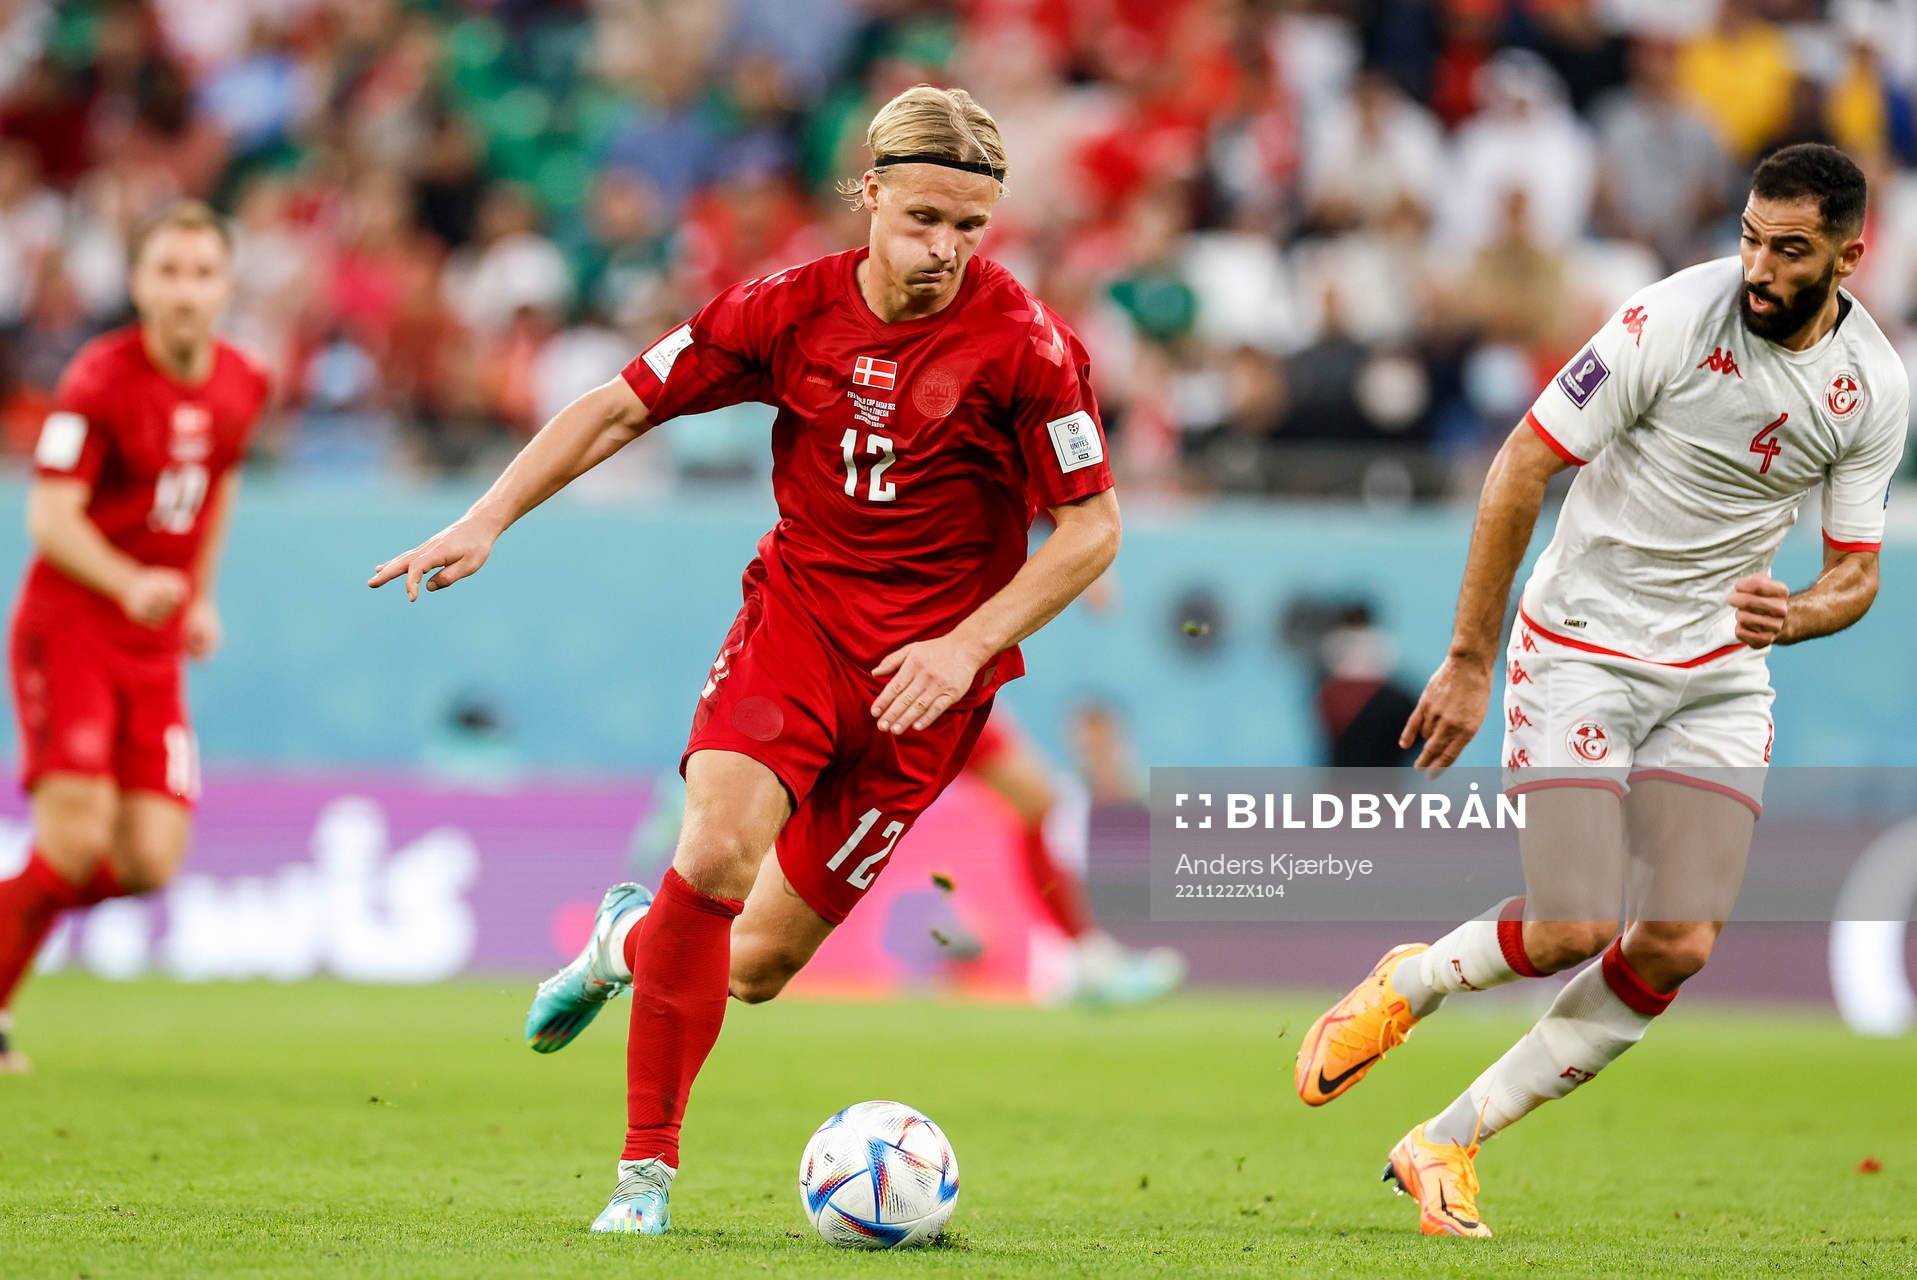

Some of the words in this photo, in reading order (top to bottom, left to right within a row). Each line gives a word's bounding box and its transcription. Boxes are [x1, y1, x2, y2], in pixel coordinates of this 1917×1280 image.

[840, 428, 896, 501] 12
[1070, 439, 1089, 450] UNITES
[1749, 412, 1789, 475] 4
[826, 807, 905, 891] 12
